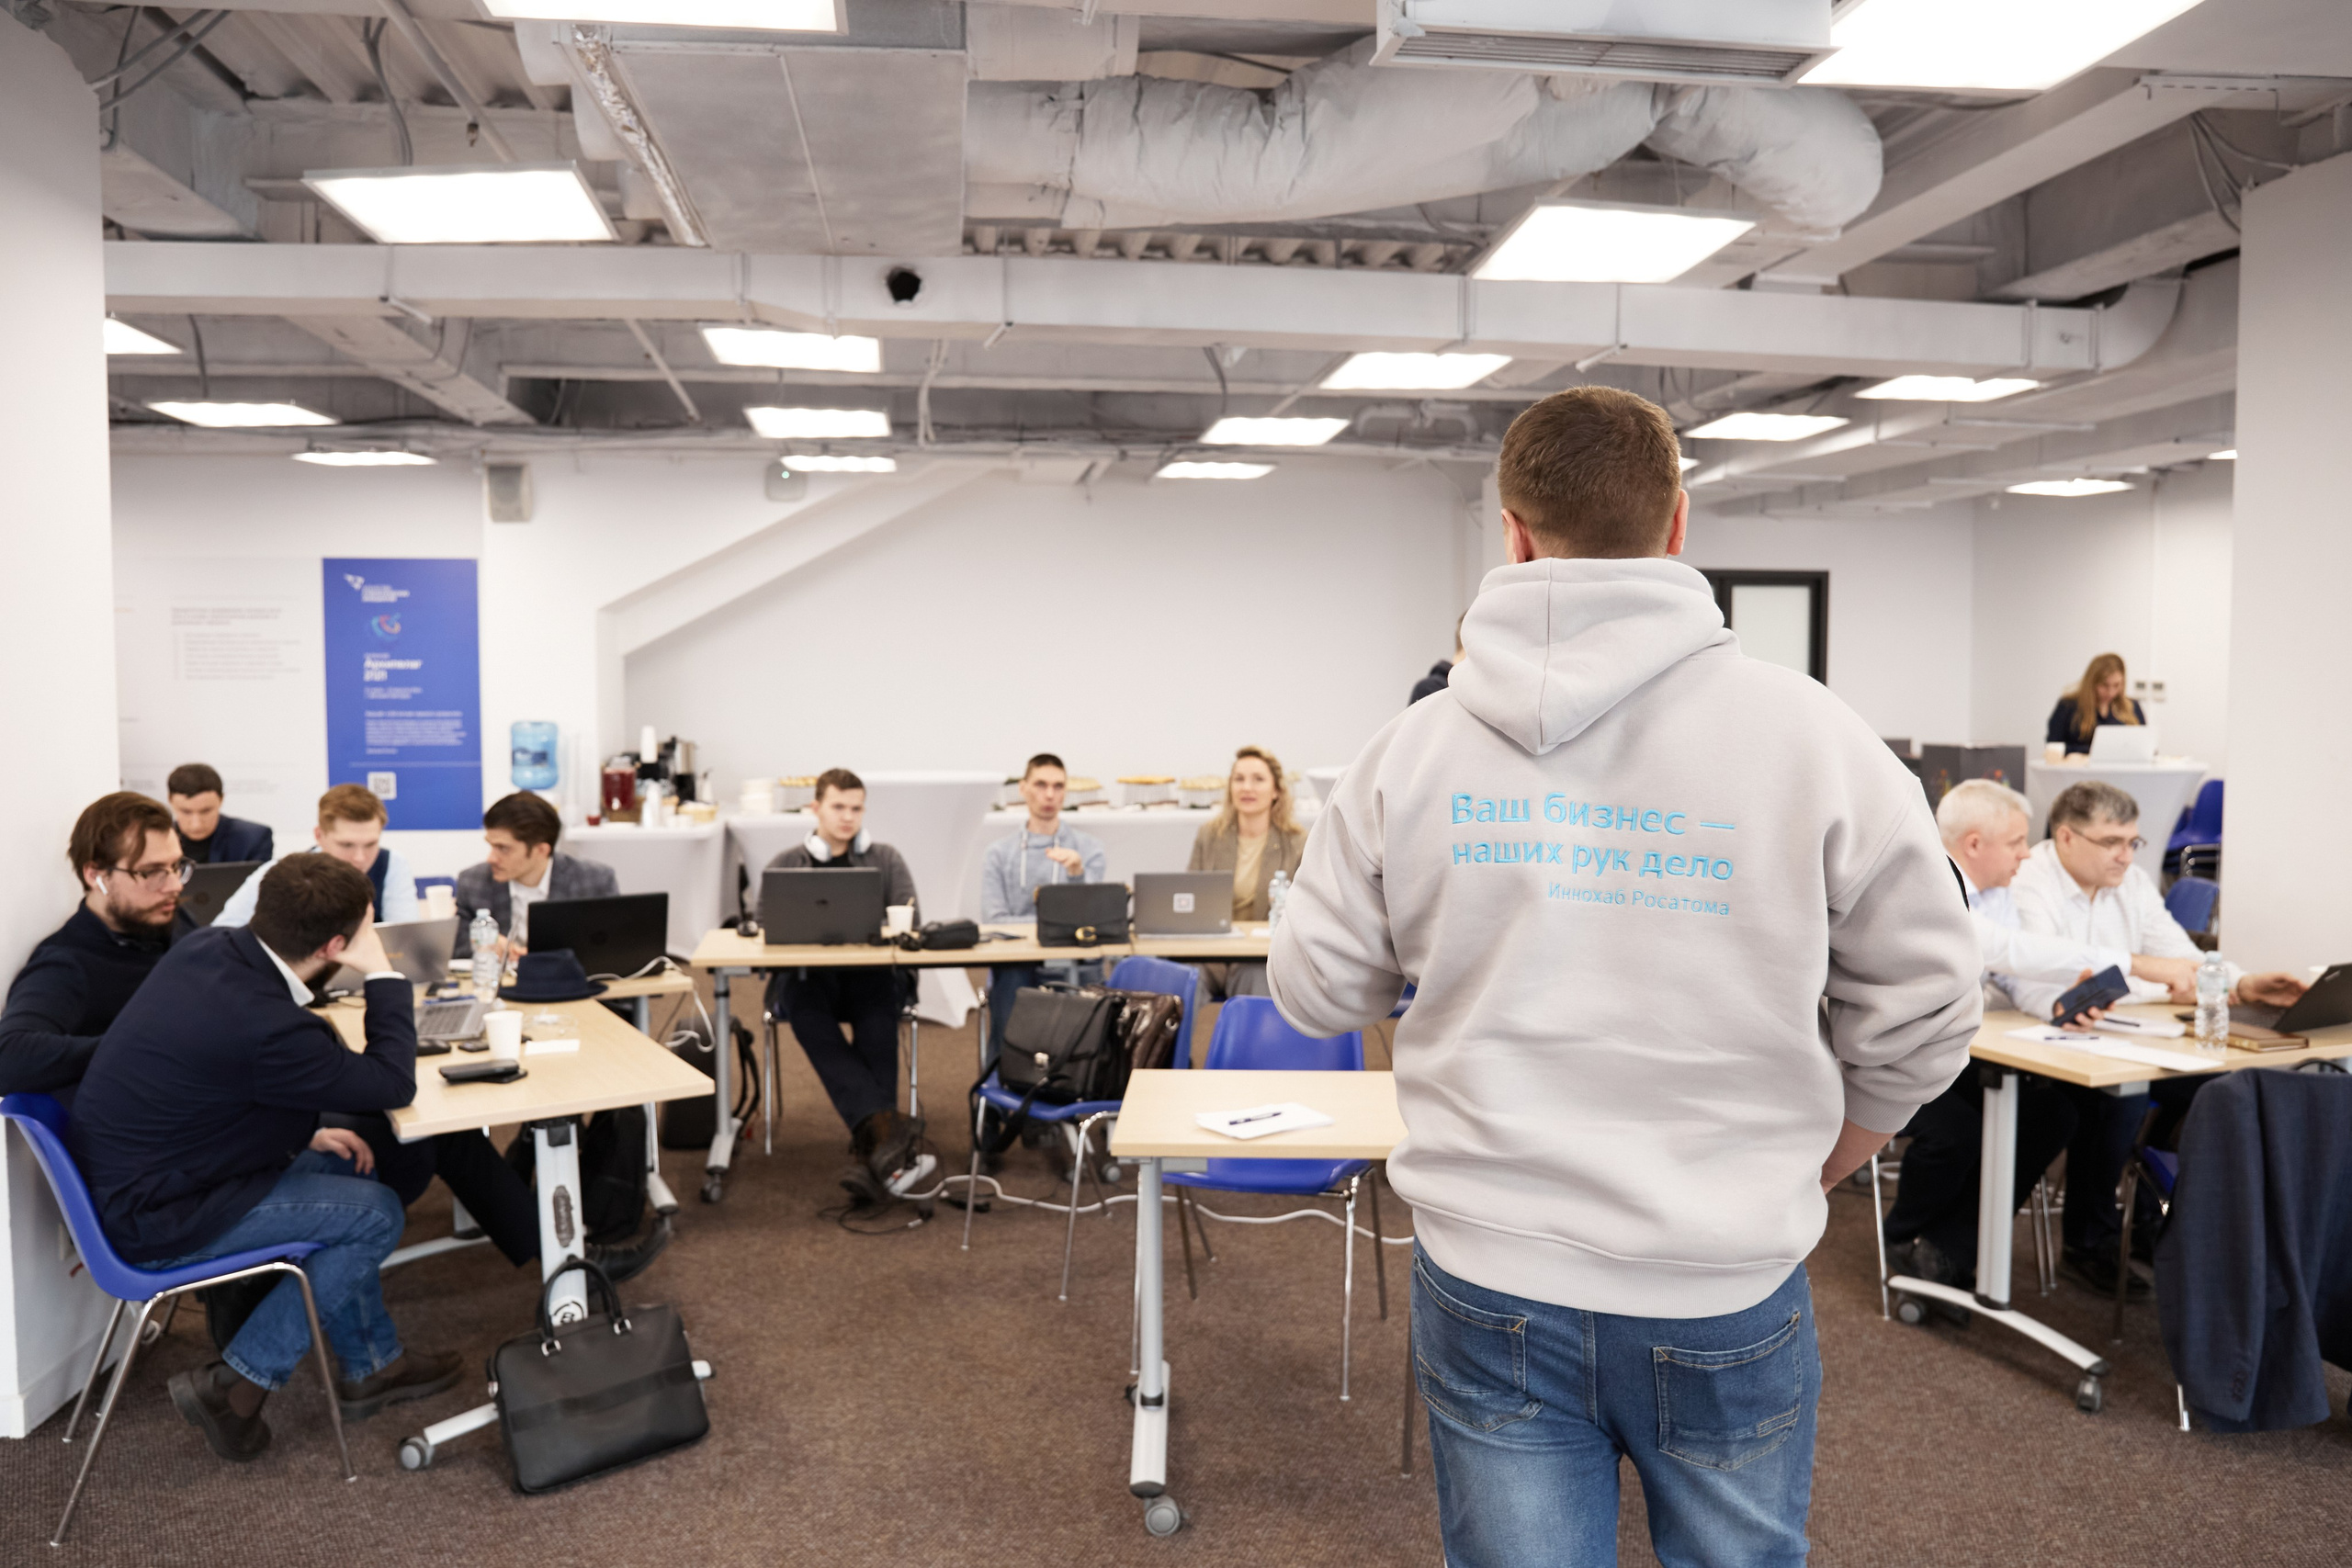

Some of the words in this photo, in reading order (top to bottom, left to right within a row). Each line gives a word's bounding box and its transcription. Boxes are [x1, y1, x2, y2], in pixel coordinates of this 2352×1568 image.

[1452, 793, 1531, 825] Ваш
[1544, 791, 1687, 836] бизнес
[1453, 841, 1564, 865] наших
[1572, 844, 1631, 877] рук
[1638, 851, 1734, 881] дело
[1548, 882, 1626, 906] Иннохаб
[1632, 889, 1730, 916] Росатома
